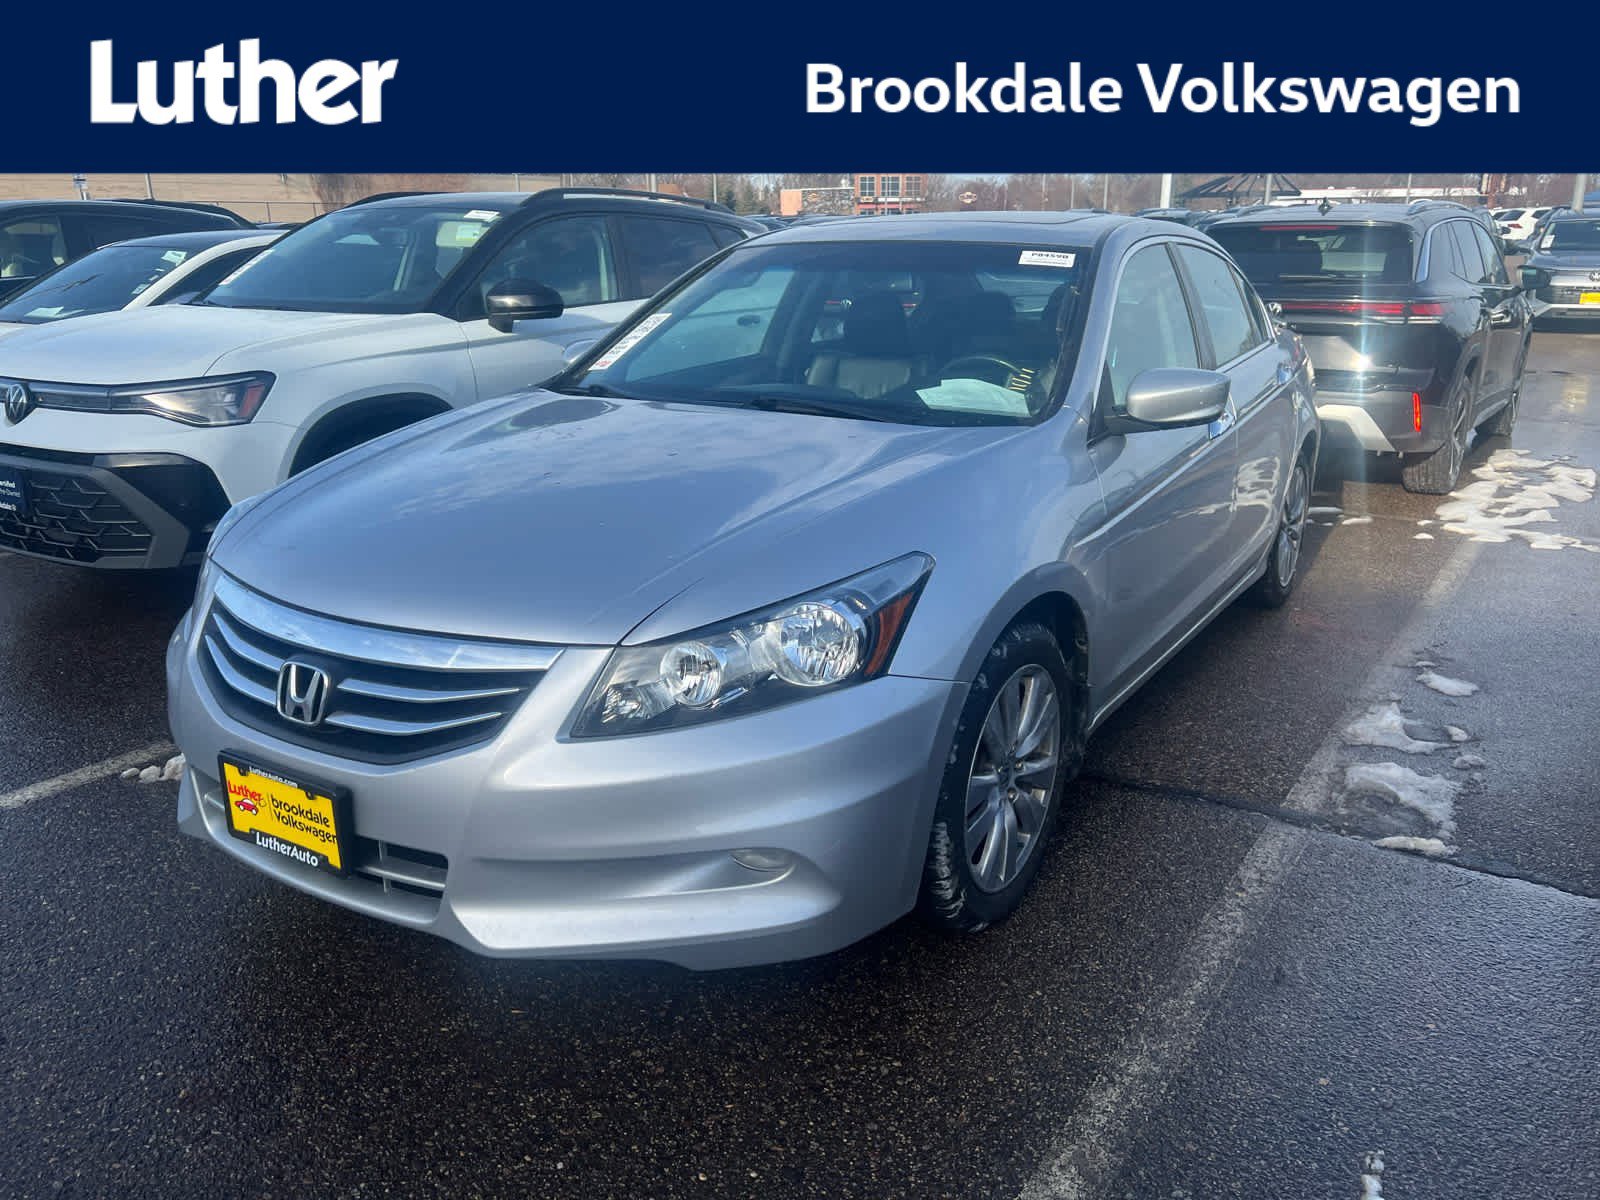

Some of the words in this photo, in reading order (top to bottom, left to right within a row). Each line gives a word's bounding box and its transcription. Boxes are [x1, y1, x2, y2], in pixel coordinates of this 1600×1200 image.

[227, 781, 263, 802] Luther
[271, 796, 330, 828] brookdale
[256, 832, 319, 867] LutherAuto
